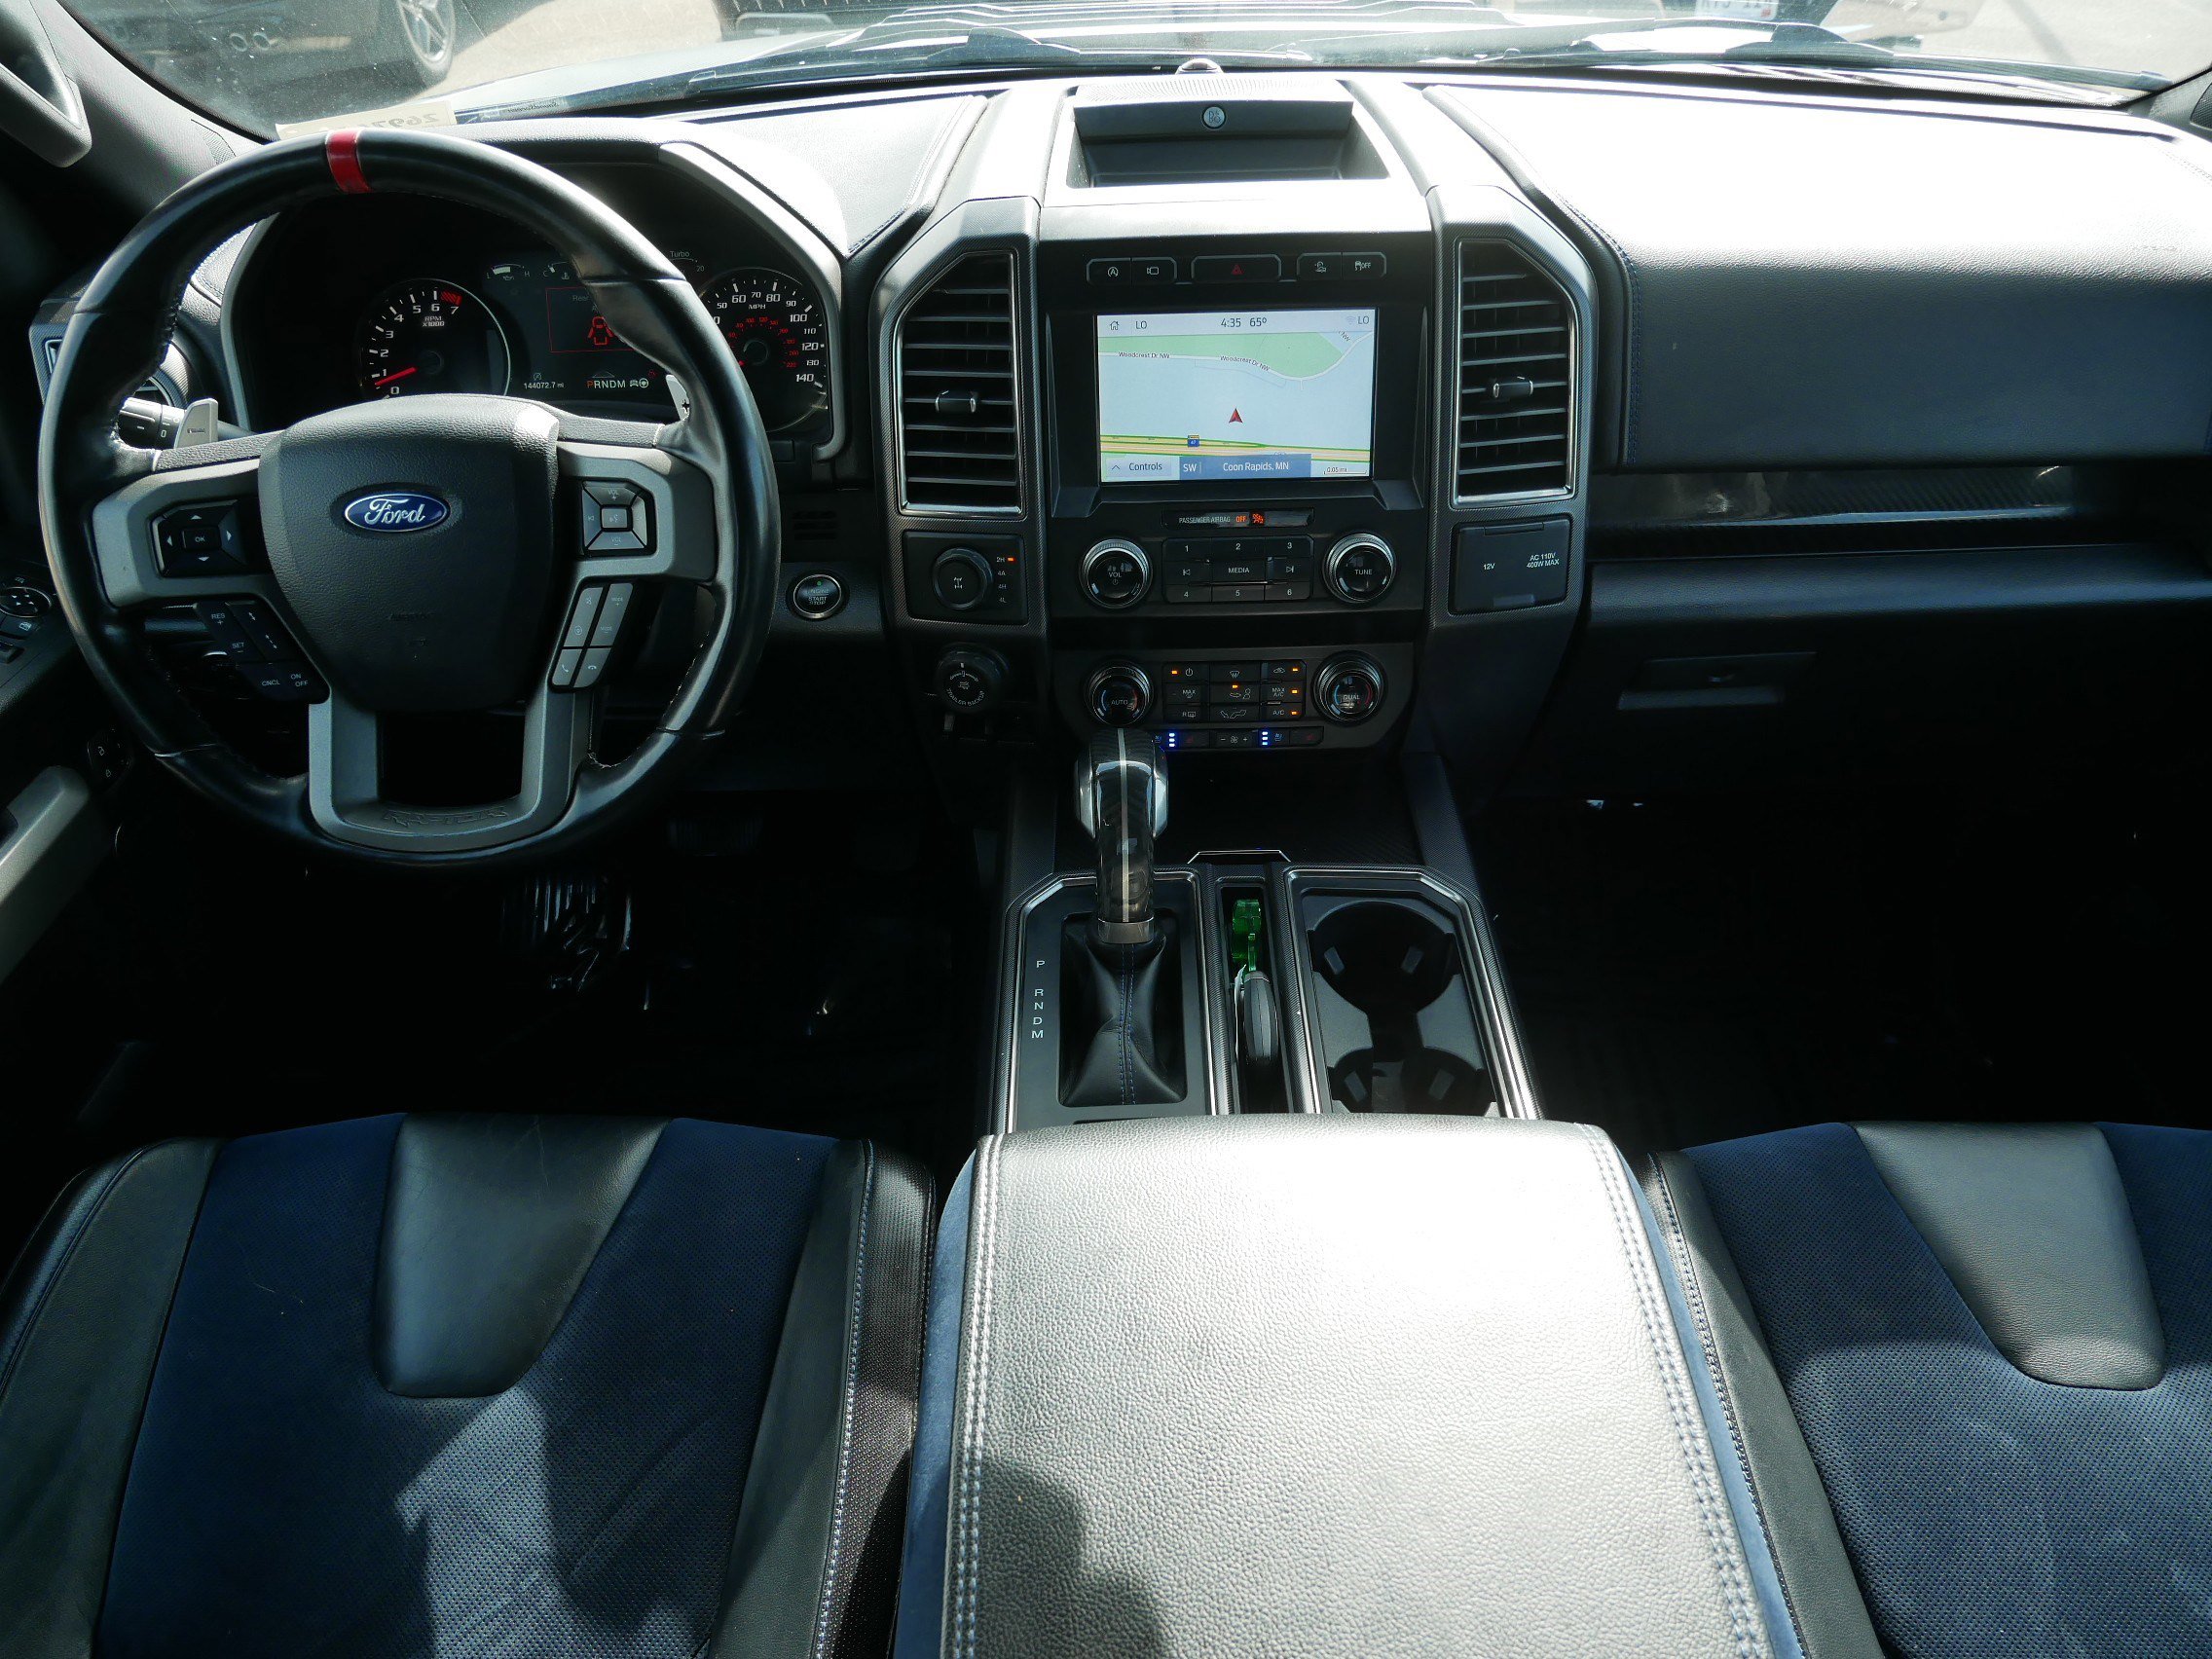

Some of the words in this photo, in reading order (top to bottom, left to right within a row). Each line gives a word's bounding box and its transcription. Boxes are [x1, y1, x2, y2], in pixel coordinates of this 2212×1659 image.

[731, 295, 747, 304] 60
[766, 293, 781, 303] 80
[413, 305, 422, 314] 5
[430, 303, 440, 312] 6
[450, 306, 460, 315] 7
[393, 313, 405, 322] 4
[790, 313, 808, 322] 100
[1357, 315, 1370, 325] LO
[1135, 320, 1148, 330] LO
[1220, 317, 1241, 328] 4:35
[385, 330, 394, 339] 3
[801, 342, 819, 350] 120
[380, 349, 389, 357] 2
[1220, 355, 1252, 364] Woodcrest
[1259, 362, 1271, 372] NW
[382, 368, 387, 377] 1
[795, 374, 814, 383] 140
[390, 387, 400, 395] 0
[1128, 461, 1163, 471] Controls
[1183, 463, 1198, 472] SW
[1223, 461, 1244, 471] Coon
[1275, 461, 1289, 470] MN
[364, 498, 426, 526] Ford
[1526, 560, 1544, 569] 400W
[1544, 558, 1560, 567] MAX
[1034, 1002, 1044, 1011] N
[1032, 1016, 1043, 1025] D
[1031, 1029, 1044, 1039] M
